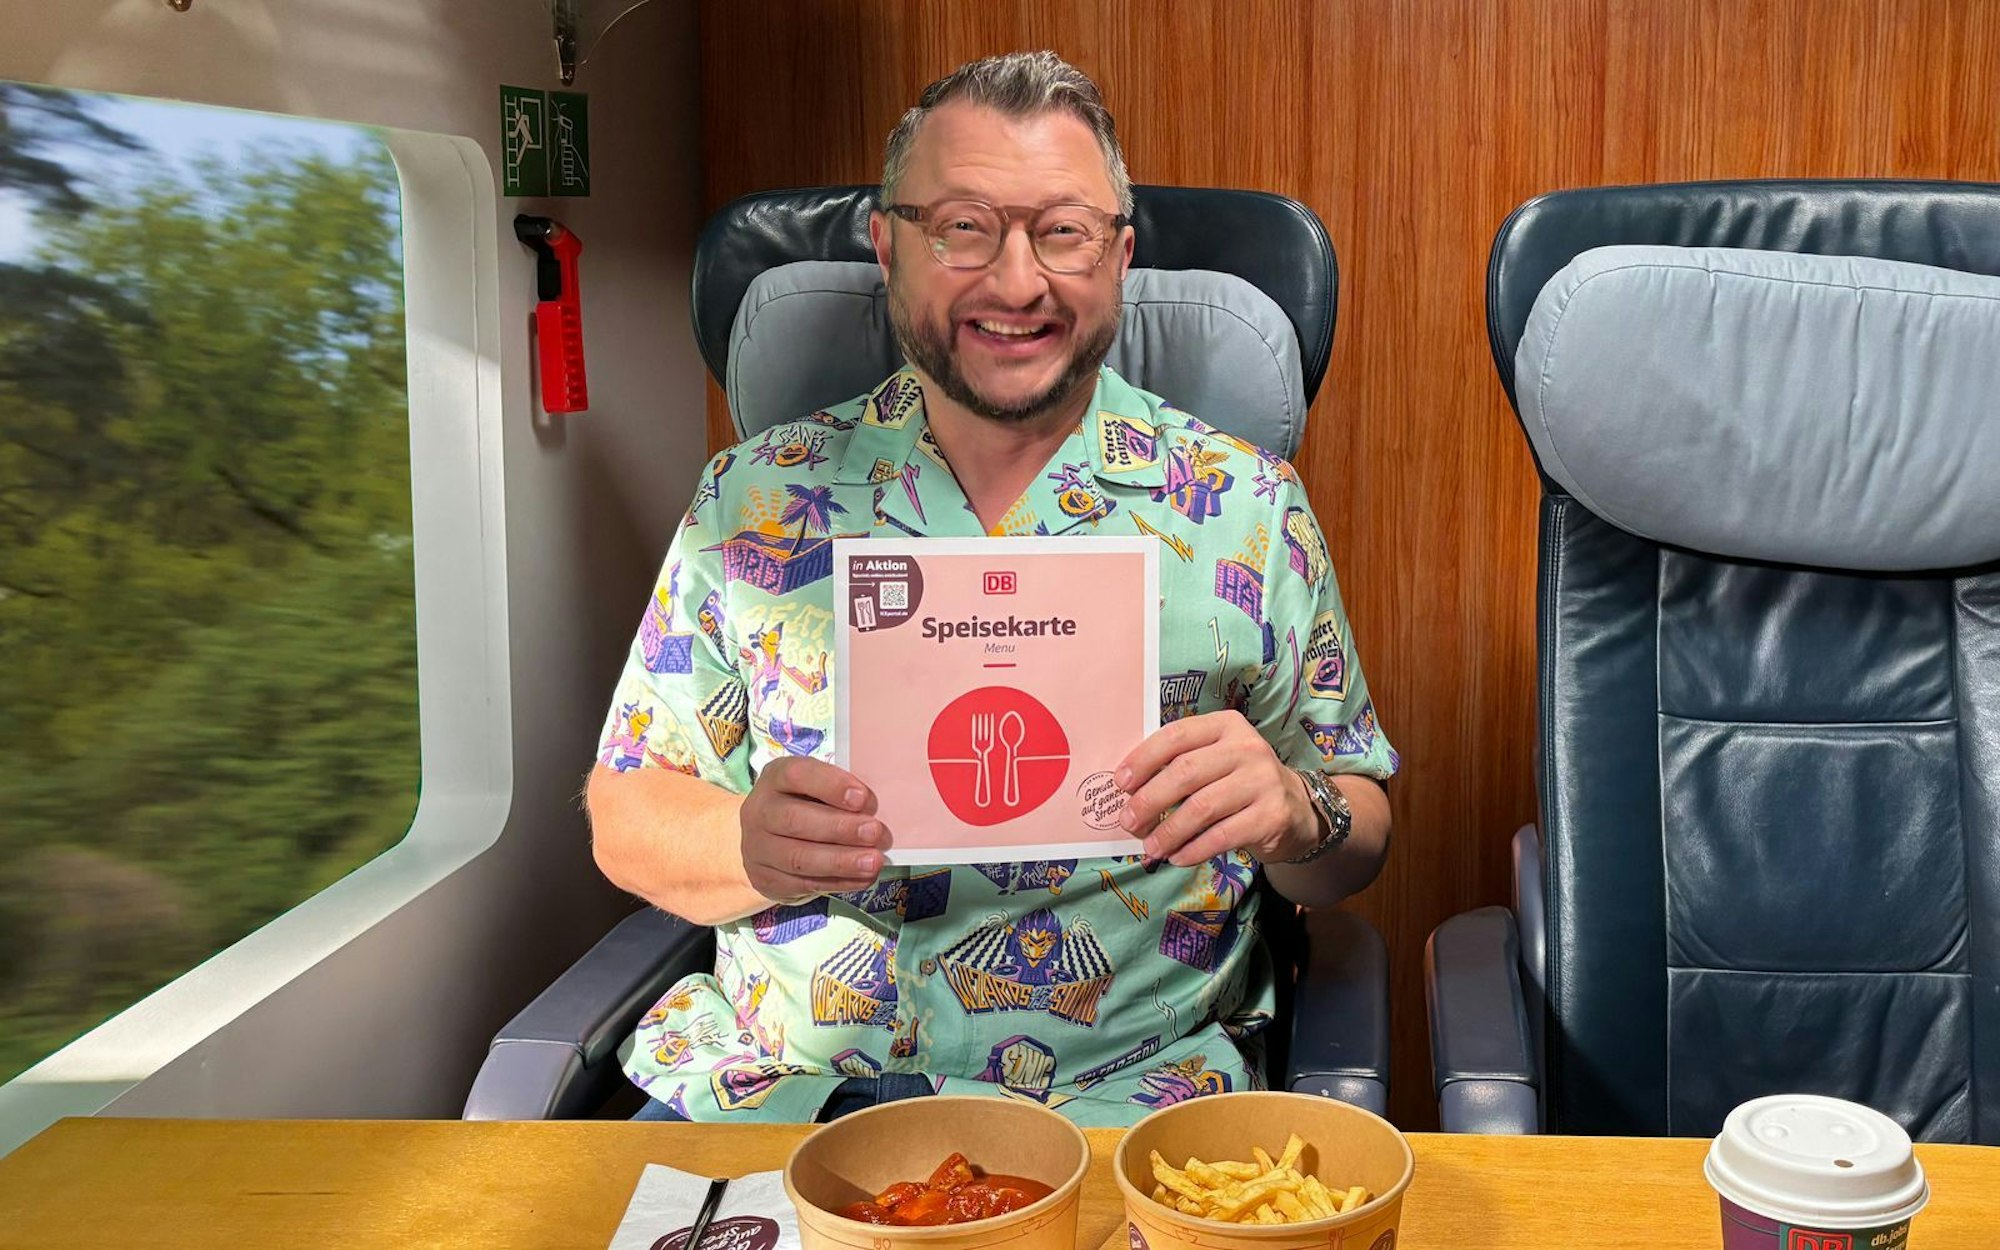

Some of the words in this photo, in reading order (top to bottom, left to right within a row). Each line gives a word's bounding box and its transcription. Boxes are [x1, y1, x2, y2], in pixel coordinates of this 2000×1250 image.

[852, 560, 864, 571] in
[866, 560, 908, 571] Aktion
[987, 575, 1013, 592] DB
[922, 615, 1077, 643] Speisekarte
[984, 643, 1016, 654] Menu
[1081, 797, 1097, 817] auf
